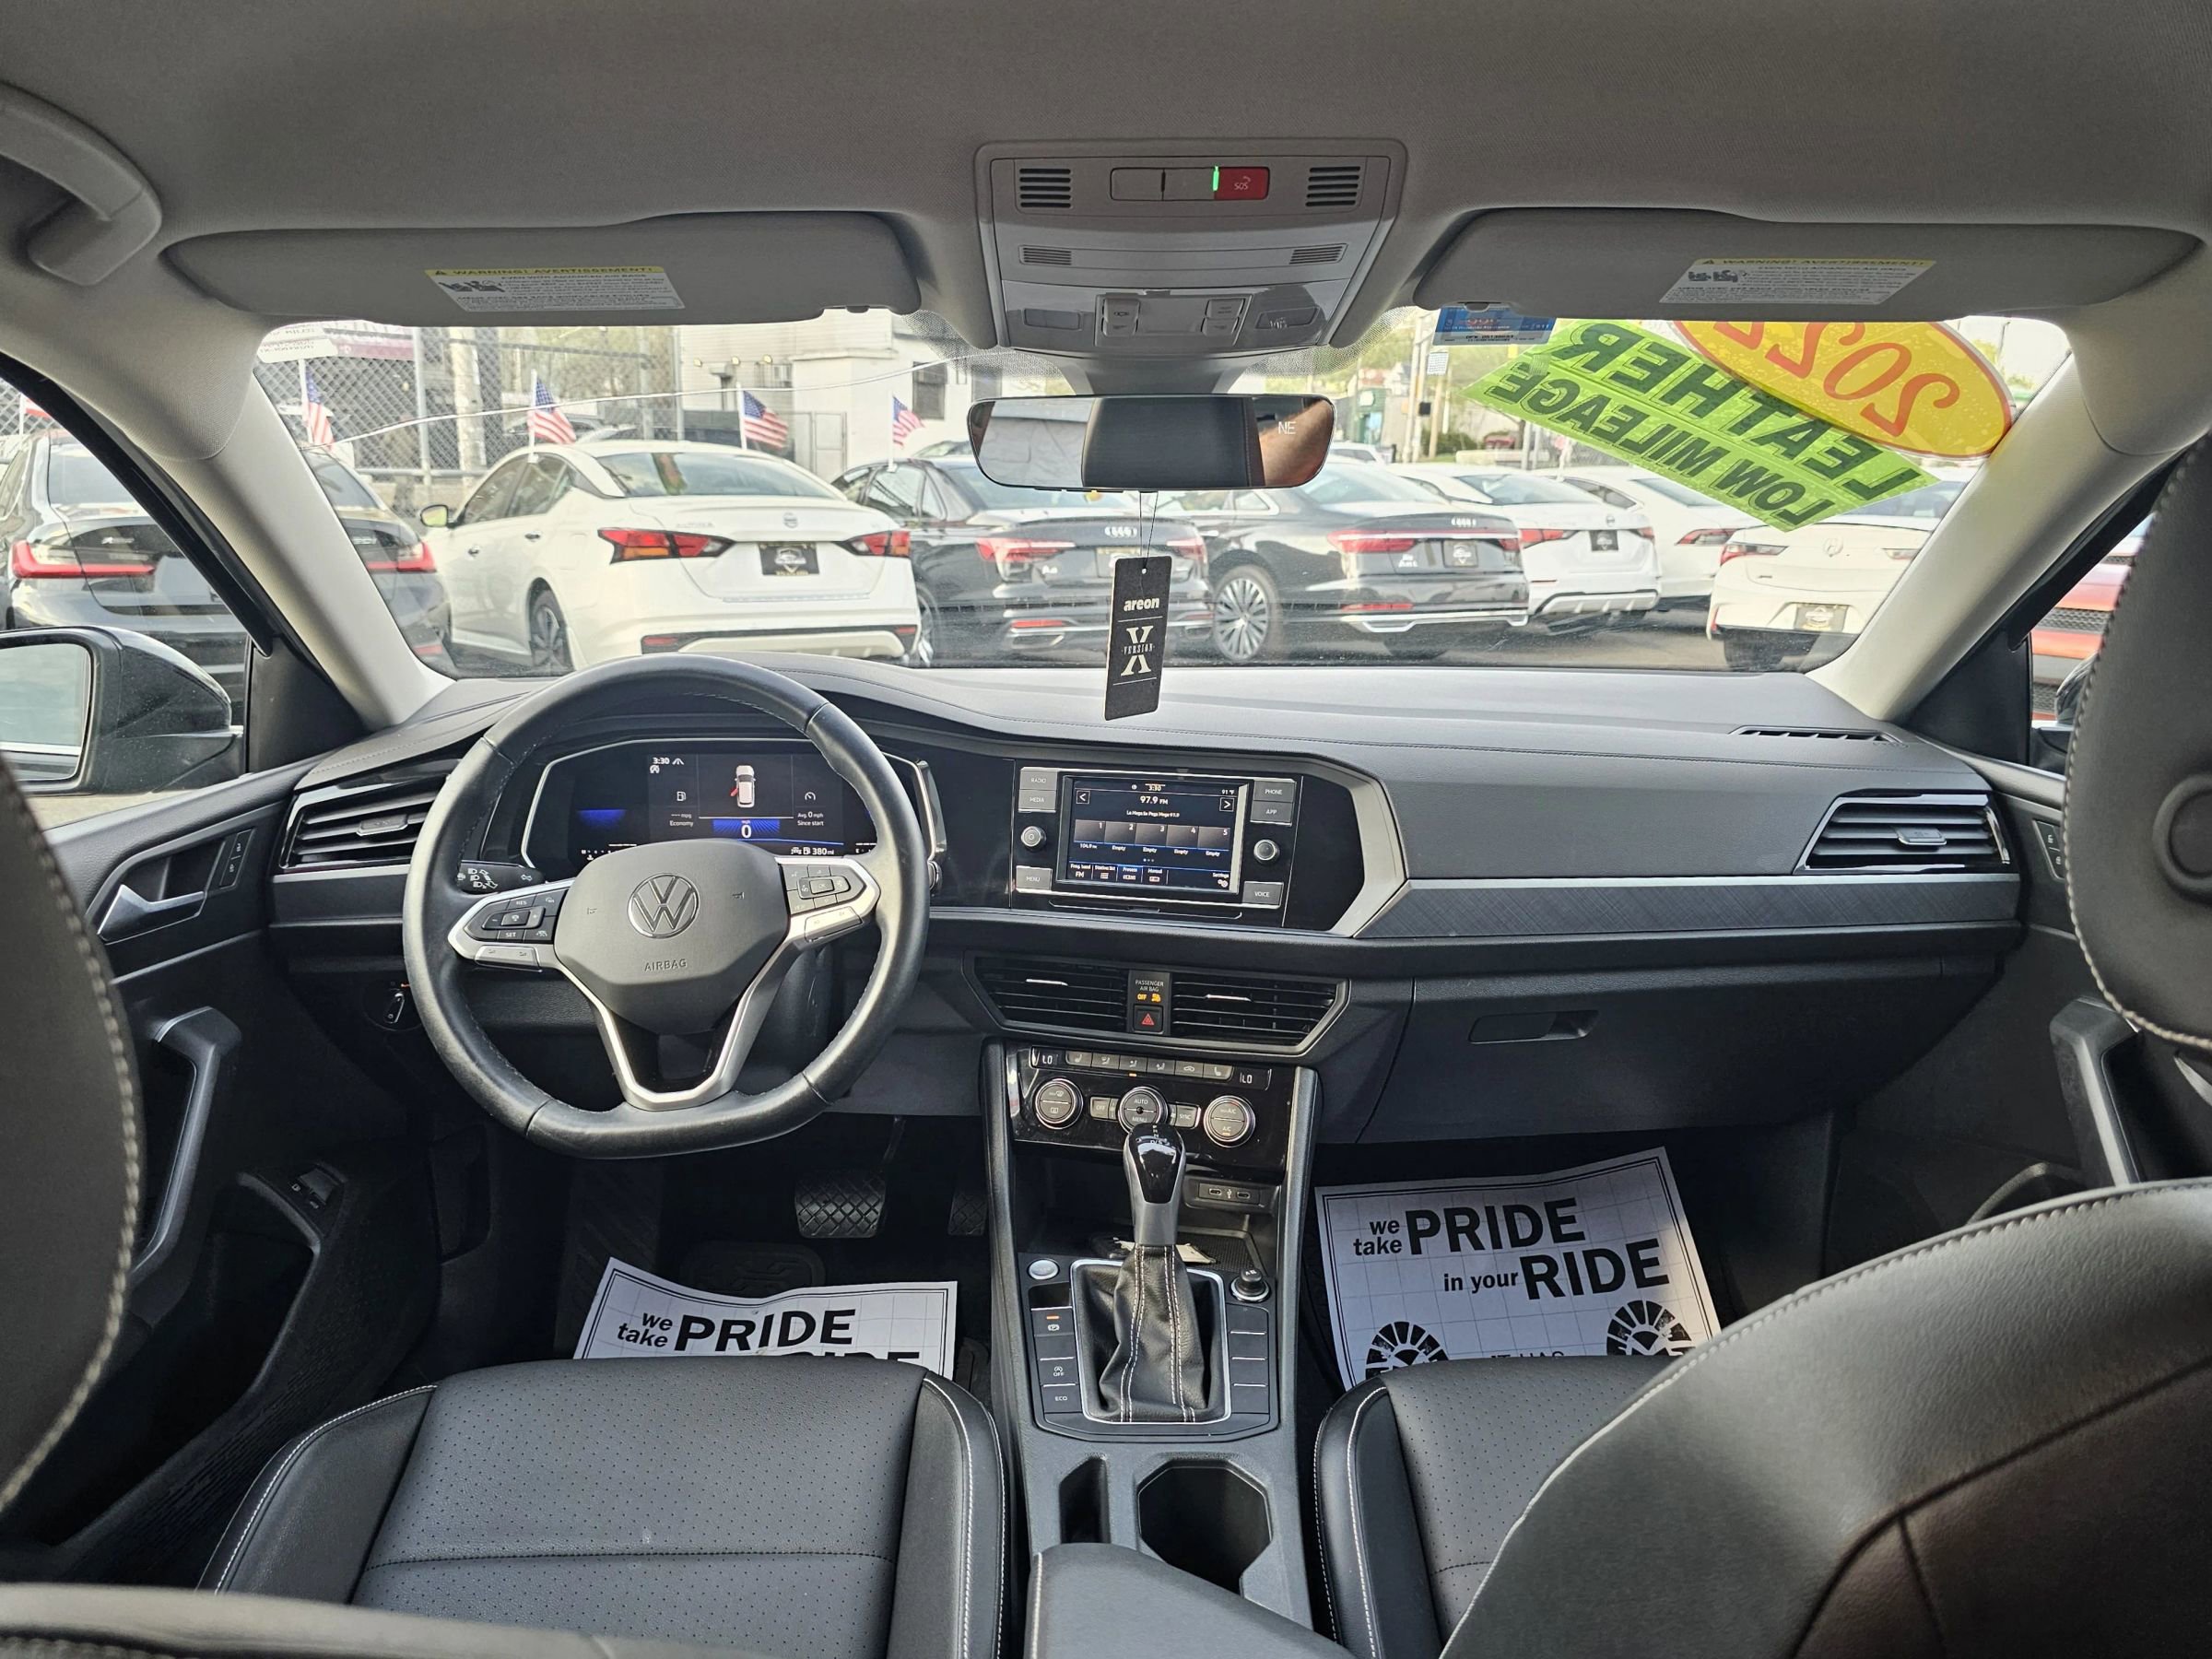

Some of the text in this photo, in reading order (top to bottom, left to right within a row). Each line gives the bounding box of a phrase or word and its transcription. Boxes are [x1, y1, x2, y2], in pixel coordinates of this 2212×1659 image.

[1278, 421, 1296, 434] NE
[1124, 597, 1160, 612] areon
[653, 757, 670, 765] 3:30
[1139, 795, 1159, 805] 97.9
[741, 825, 751, 838] 0
[812, 847, 827, 855] 380
[644, 959, 687, 972] AIRBAG
[1135, 979, 1164, 987] PASSENGER
[1041, 1054, 1053, 1065] LO
[1353, 1198, 1586, 1256] take PRIDE
[1370, 1219, 1400, 1235] we
[1443, 1238, 1670, 1300] in your RIDE
[641, 1312, 673, 1331] we
[617, 1309, 856, 1352] take PRIDE
